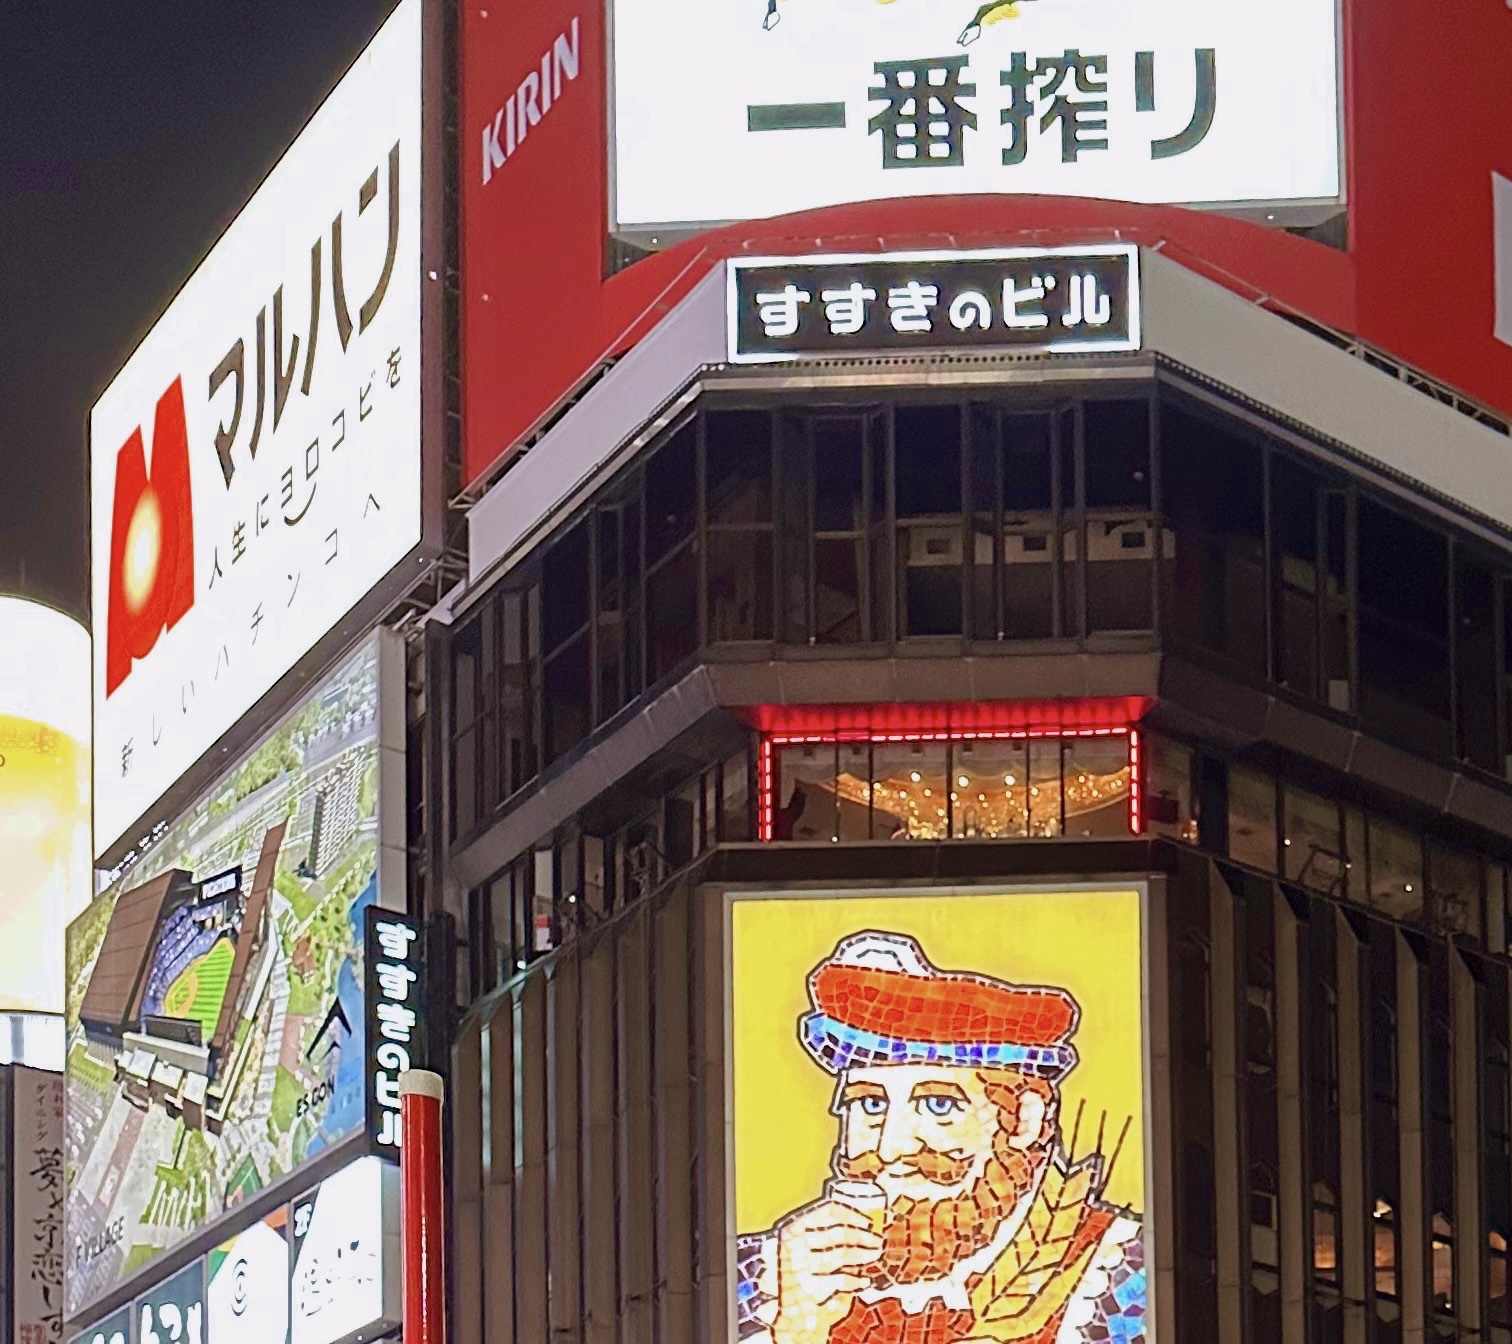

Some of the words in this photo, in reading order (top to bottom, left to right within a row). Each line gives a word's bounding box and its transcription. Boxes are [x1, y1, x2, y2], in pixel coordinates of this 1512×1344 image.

[481, 16, 582, 187] KIRIN
[746, 47, 1217, 171] 一番搾り
[207, 138, 401, 492] マルハン
[754, 272, 1113, 339] すすきのビル
[208, 346, 402, 590] 人生にヨロコビを
